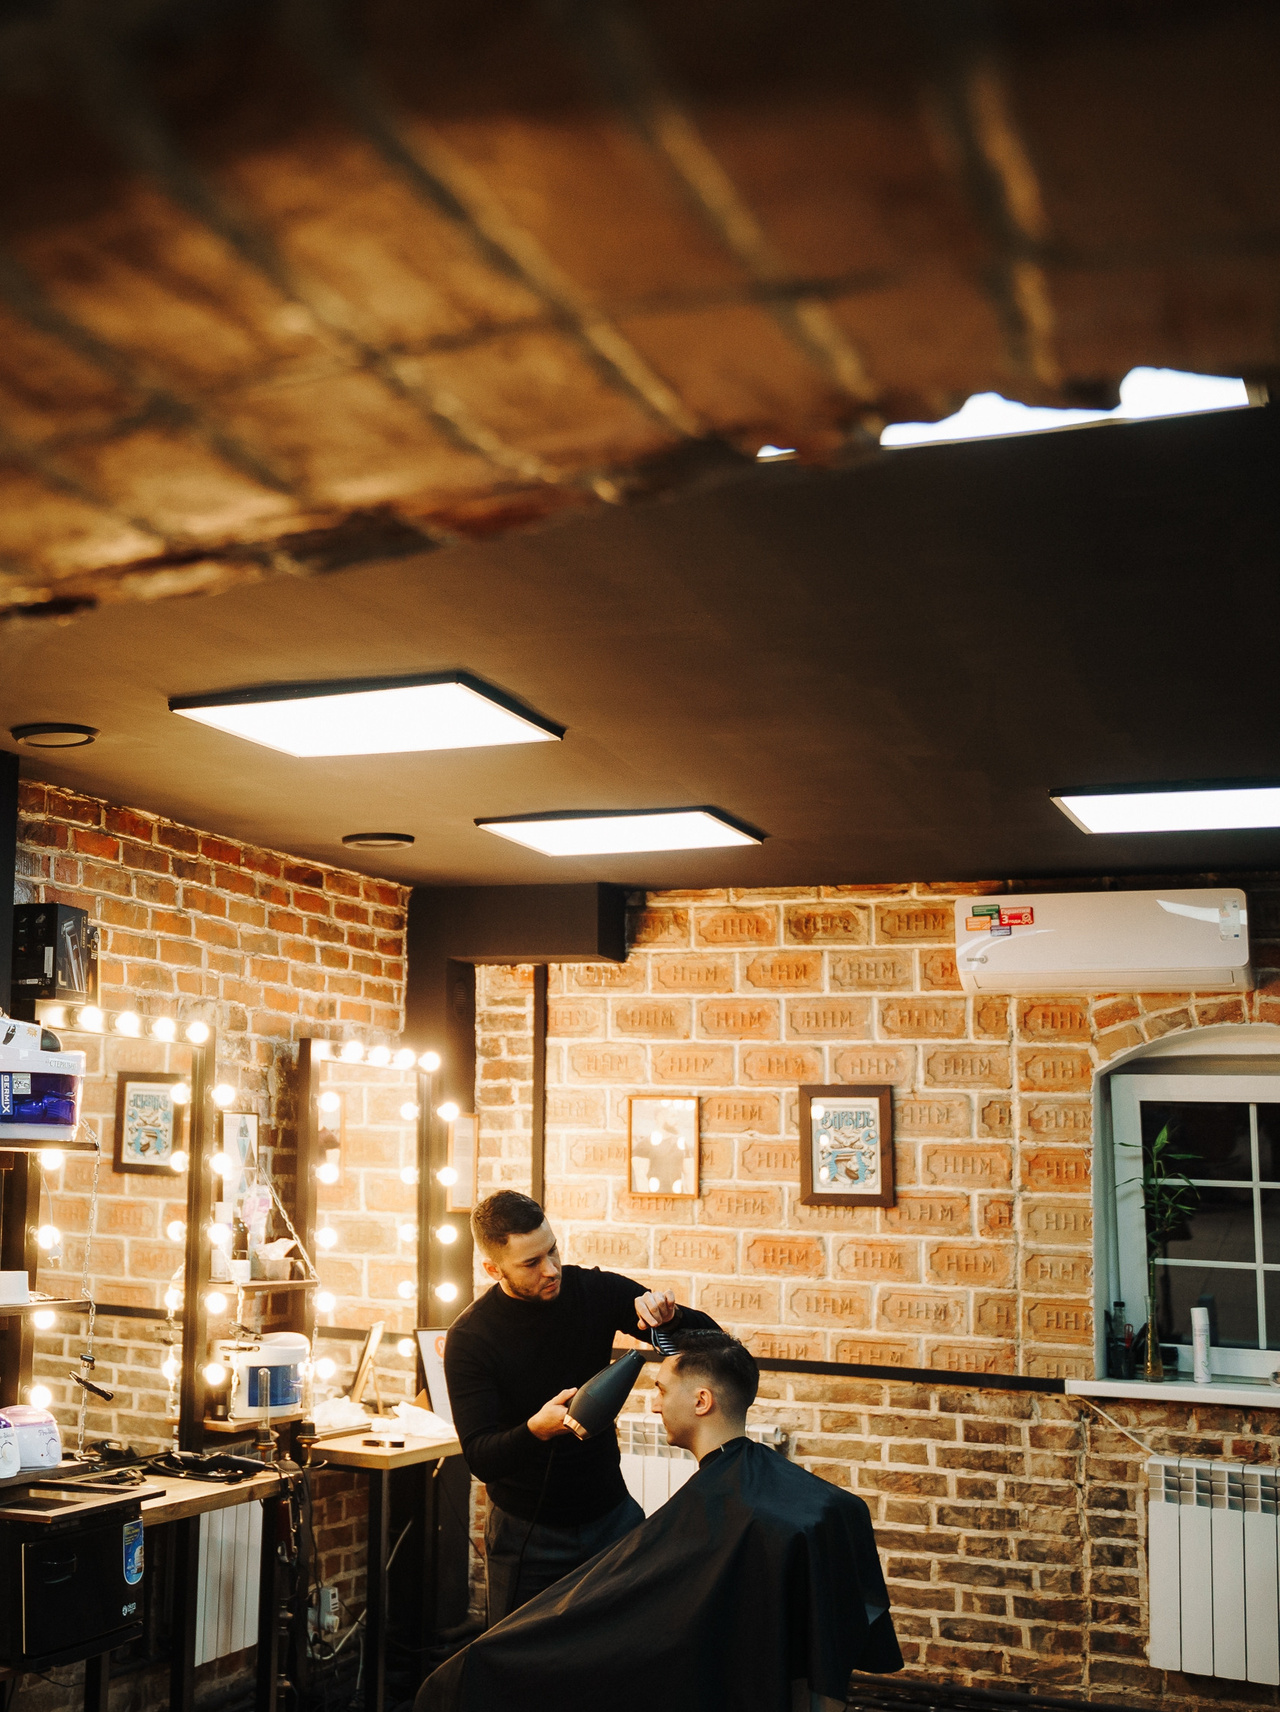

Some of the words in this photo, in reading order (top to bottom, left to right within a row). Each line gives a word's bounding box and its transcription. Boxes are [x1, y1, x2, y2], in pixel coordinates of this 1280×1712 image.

[894, 912, 947, 932] HHM
[1001, 915, 1009, 924] 3
[821, 1111, 875, 1130] BARBER
[943, 1156, 993, 1175] HHM
[854, 1250, 903, 1270] HHM
[946, 1254, 998, 1275] HHM
